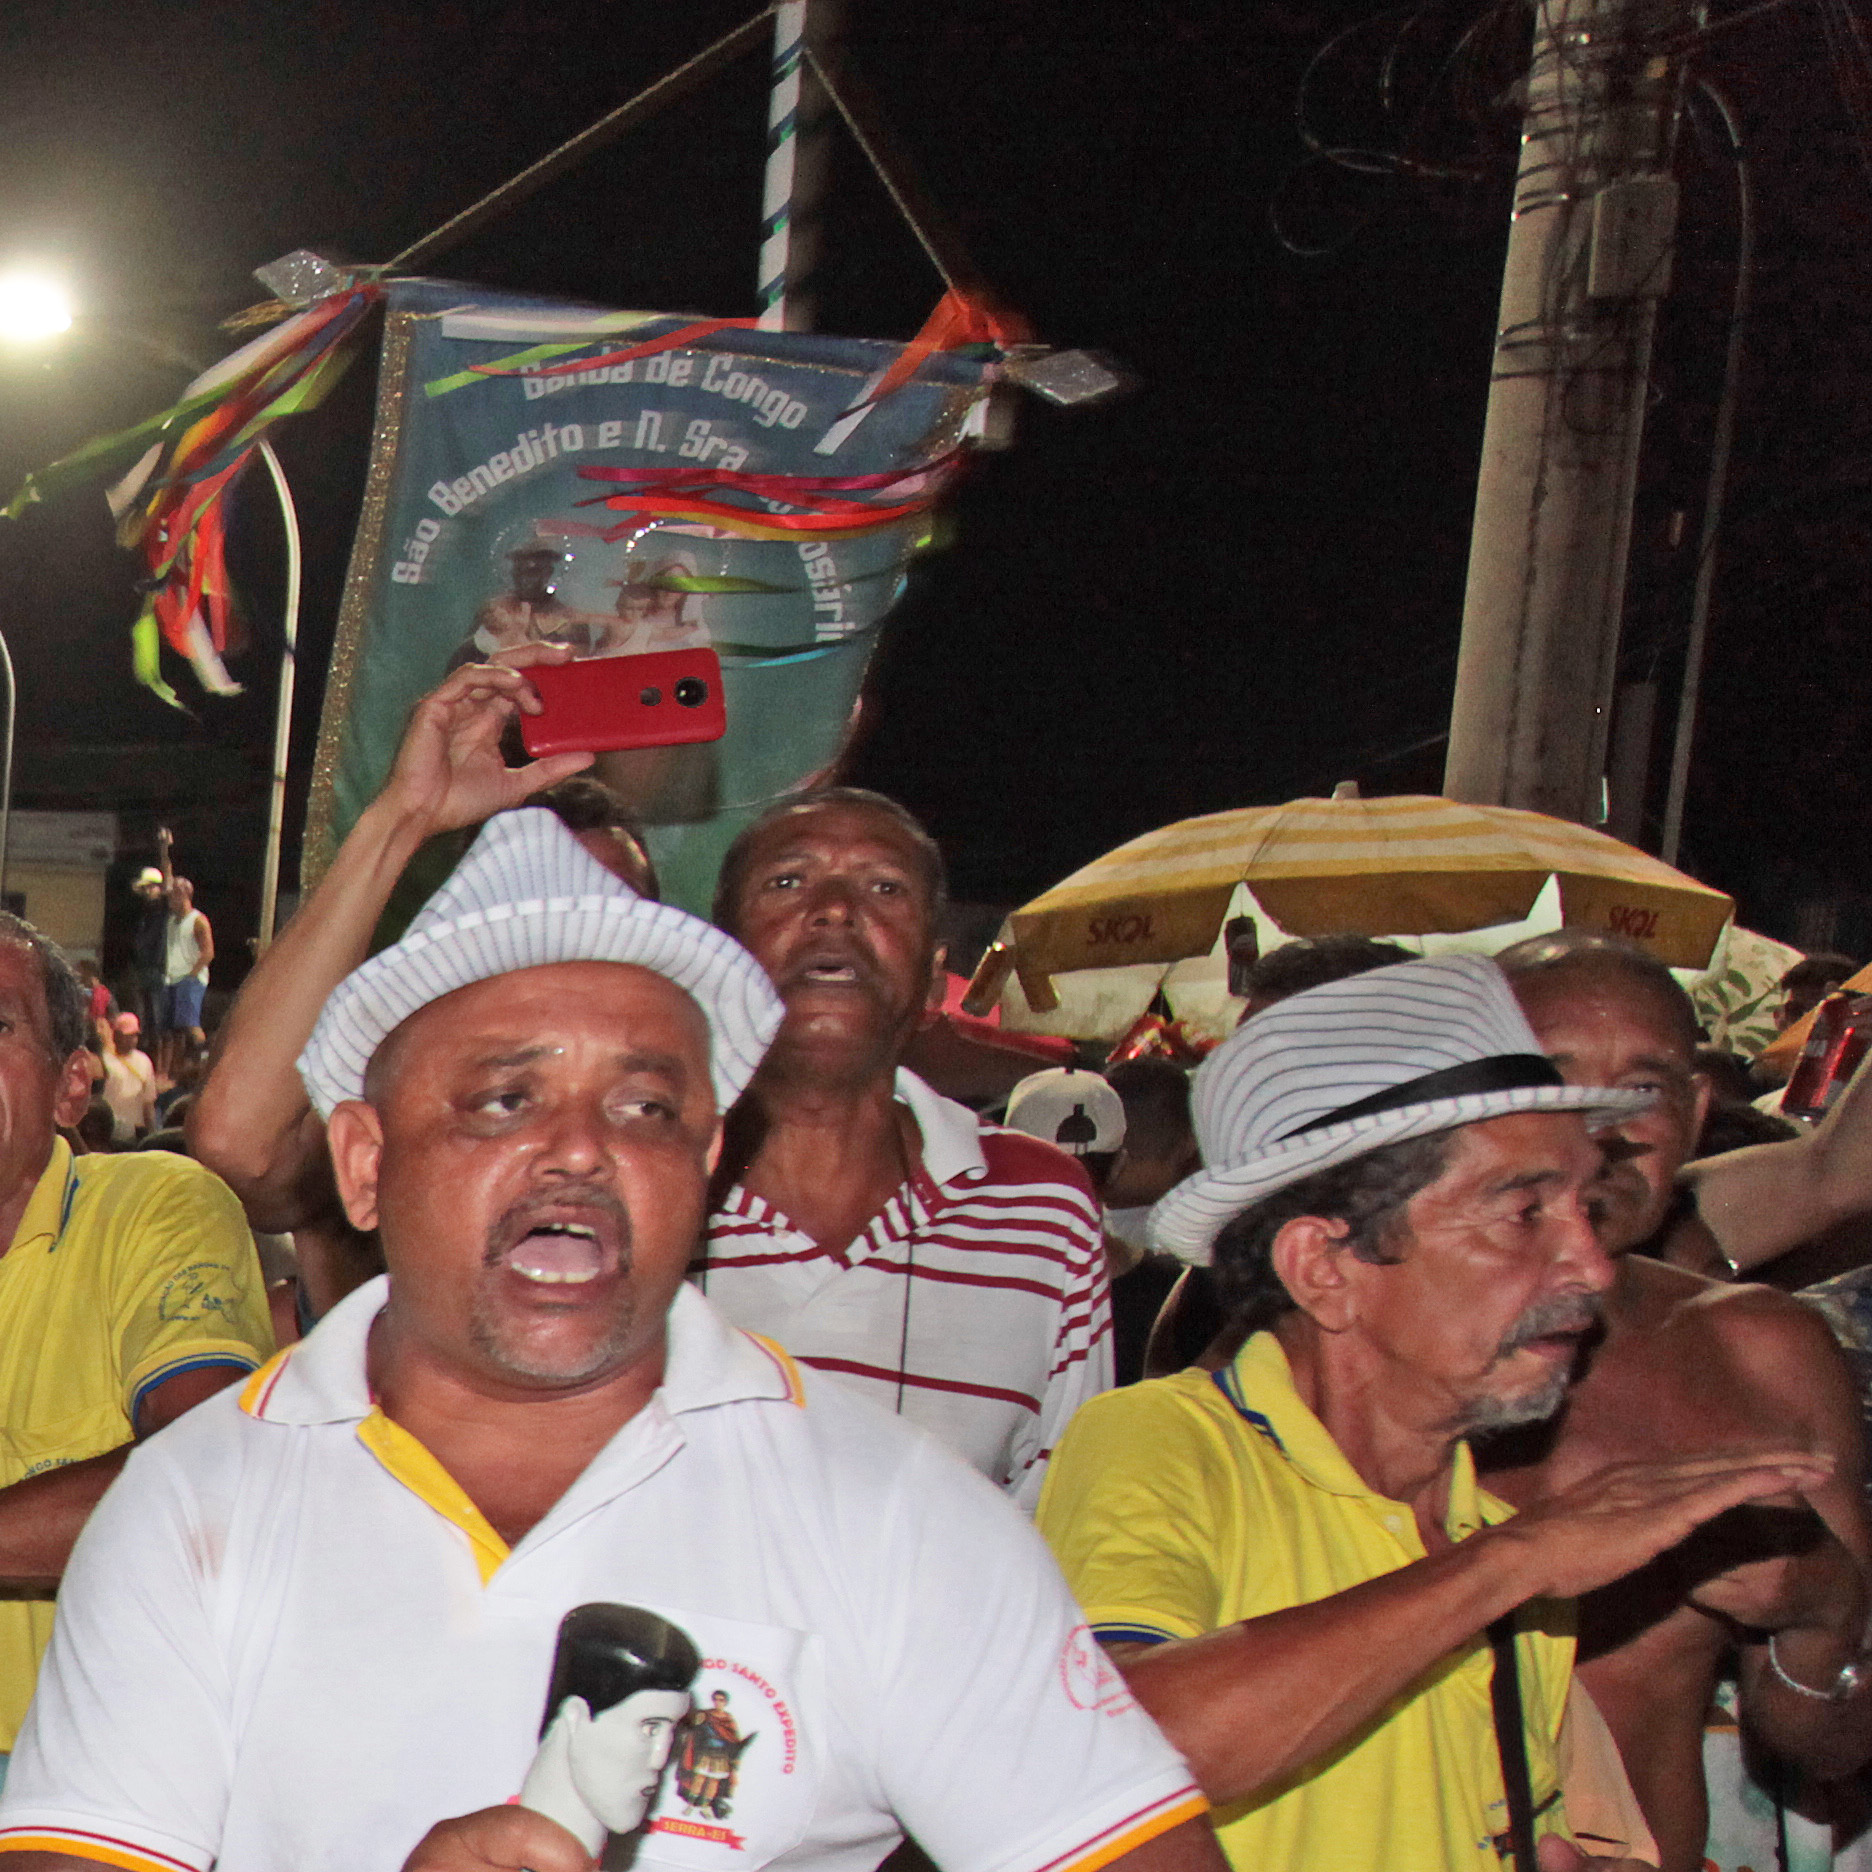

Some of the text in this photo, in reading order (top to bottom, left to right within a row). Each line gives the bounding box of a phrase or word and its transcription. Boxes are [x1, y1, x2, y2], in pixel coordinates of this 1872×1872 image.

[523, 346, 807, 430] Banda de Congo
[392, 519, 441, 585] São
[428, 420, 583, 518] Benedito
[598, 419, 622, 449] e
[678, 418, 749, 471] Sra
[1087, 914, 1155, 945] SKOL
[1609, 905, 1660, 940] SKOL
[731, 1663, 797, 1774] SANTO EXPEDITO
